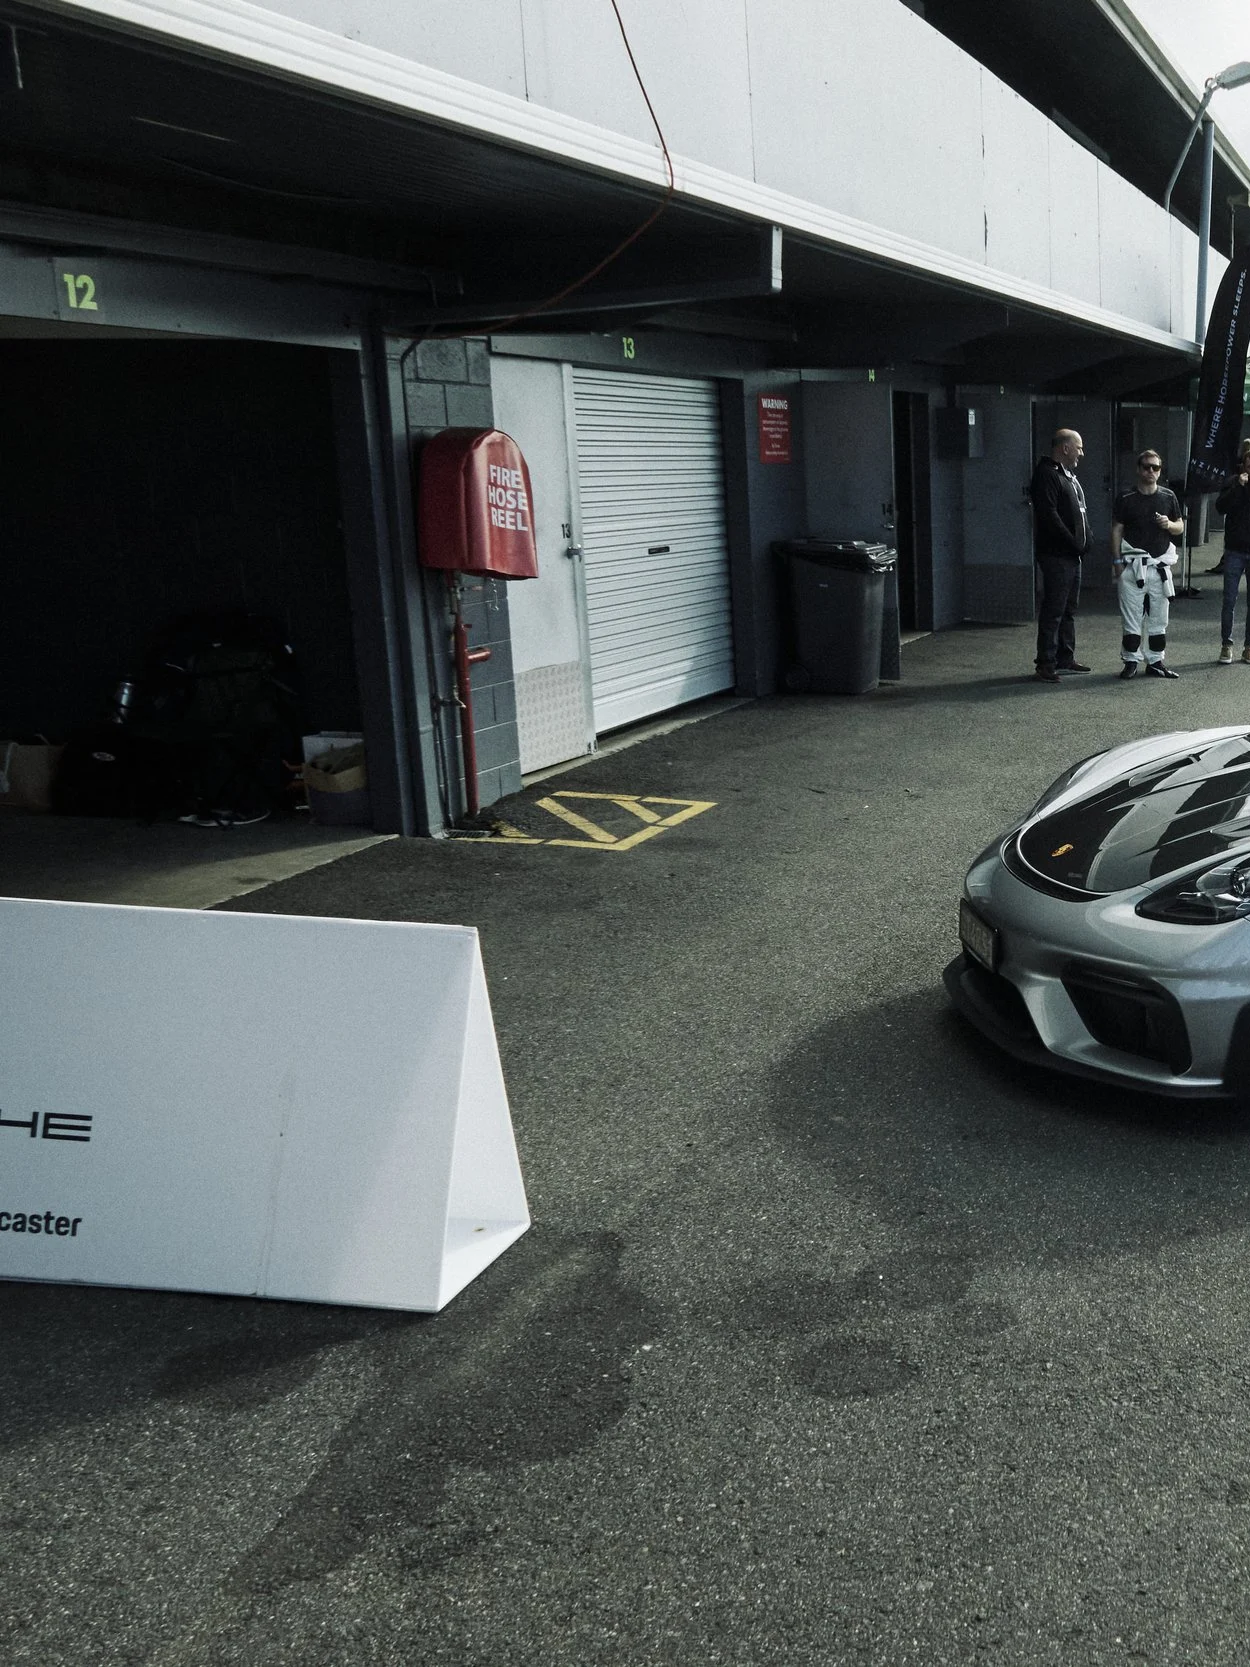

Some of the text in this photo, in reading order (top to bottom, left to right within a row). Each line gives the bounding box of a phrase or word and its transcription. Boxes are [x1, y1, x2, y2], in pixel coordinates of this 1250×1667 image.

[63, 273, 98, 310] 12
[622, 336, 635, 359] 13
[1204, 406, 1223, 448] WHERE
[1232, 269, 1247, 316] SLEEPS.
[761, 398, 788, 410] WARNING
[489, 464, 522, 489] FIRE
[488, 485, 529, 511] HOSE
[491, 507, 529, 532] REEL
[561, 523, 571, 539] 13
